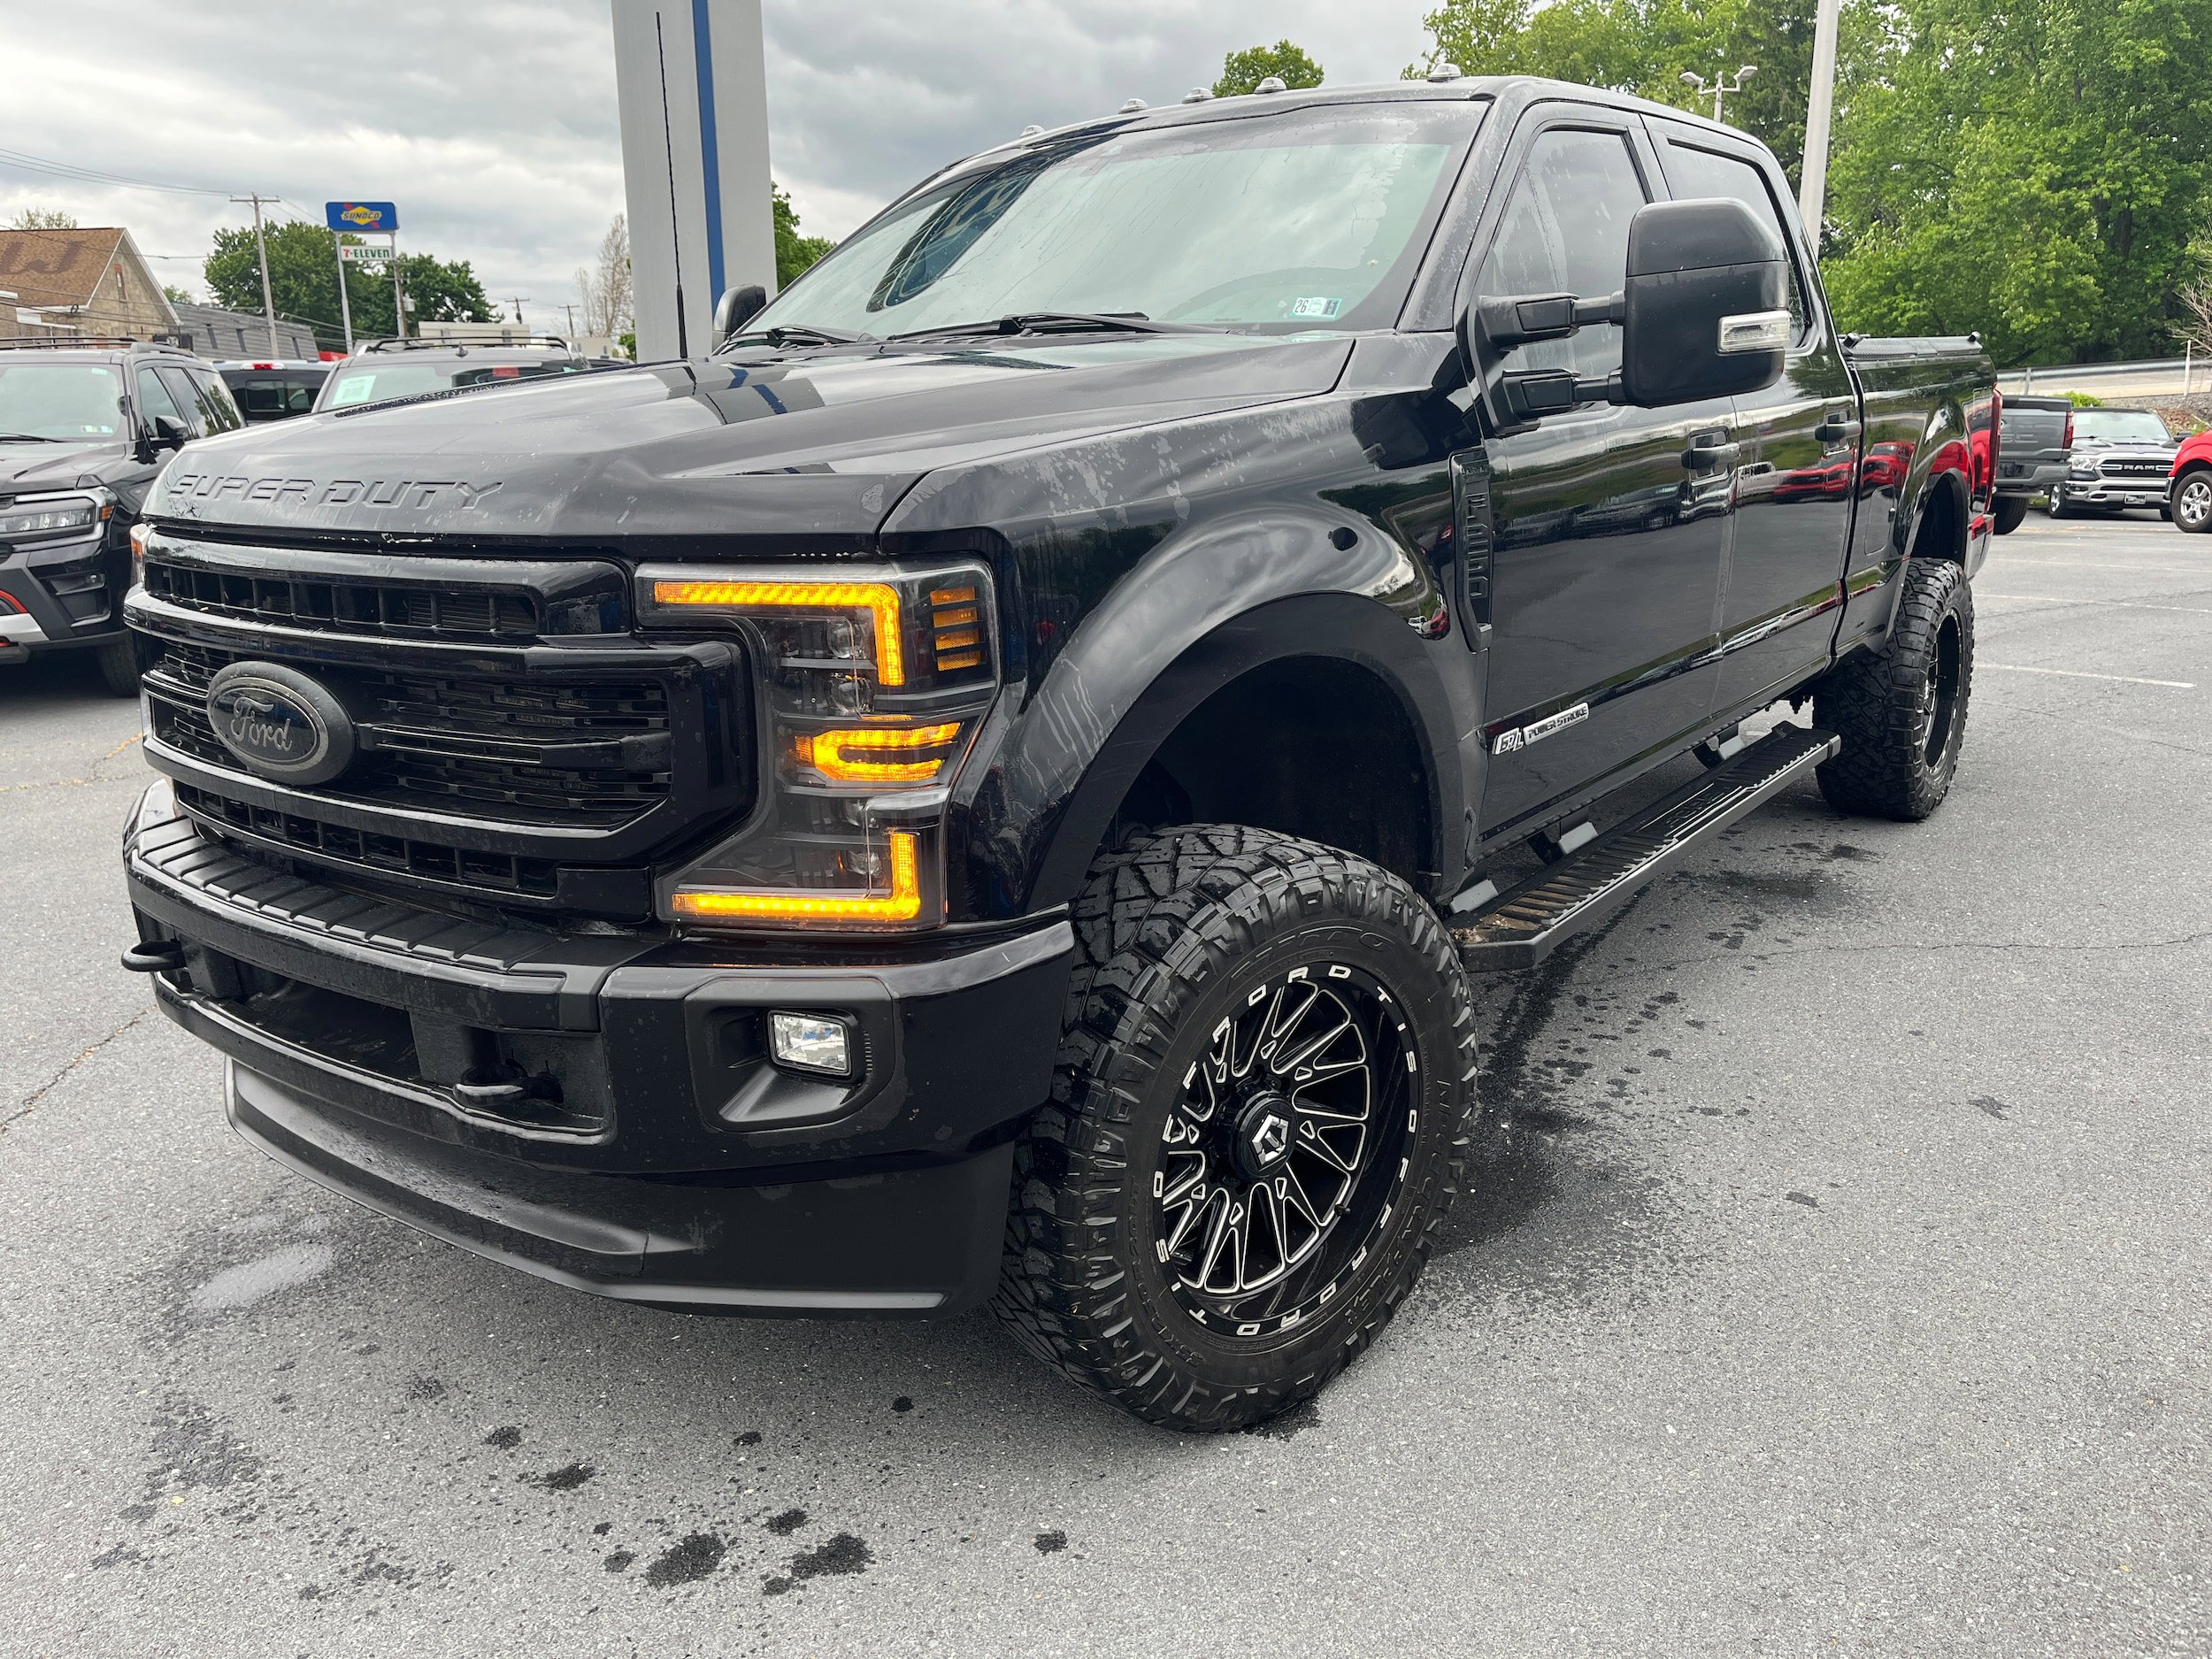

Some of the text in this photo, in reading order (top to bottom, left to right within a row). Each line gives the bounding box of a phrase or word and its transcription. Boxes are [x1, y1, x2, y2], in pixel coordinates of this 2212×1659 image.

[343, 211, 380, 220] SUNOCO
[1294, 299, 1309, 313] 26
[170, 474, 505, 511] SUPER DUTY
[230, 695, 293, 752] Ford
[1527, 719, 1557, 741] POWER
